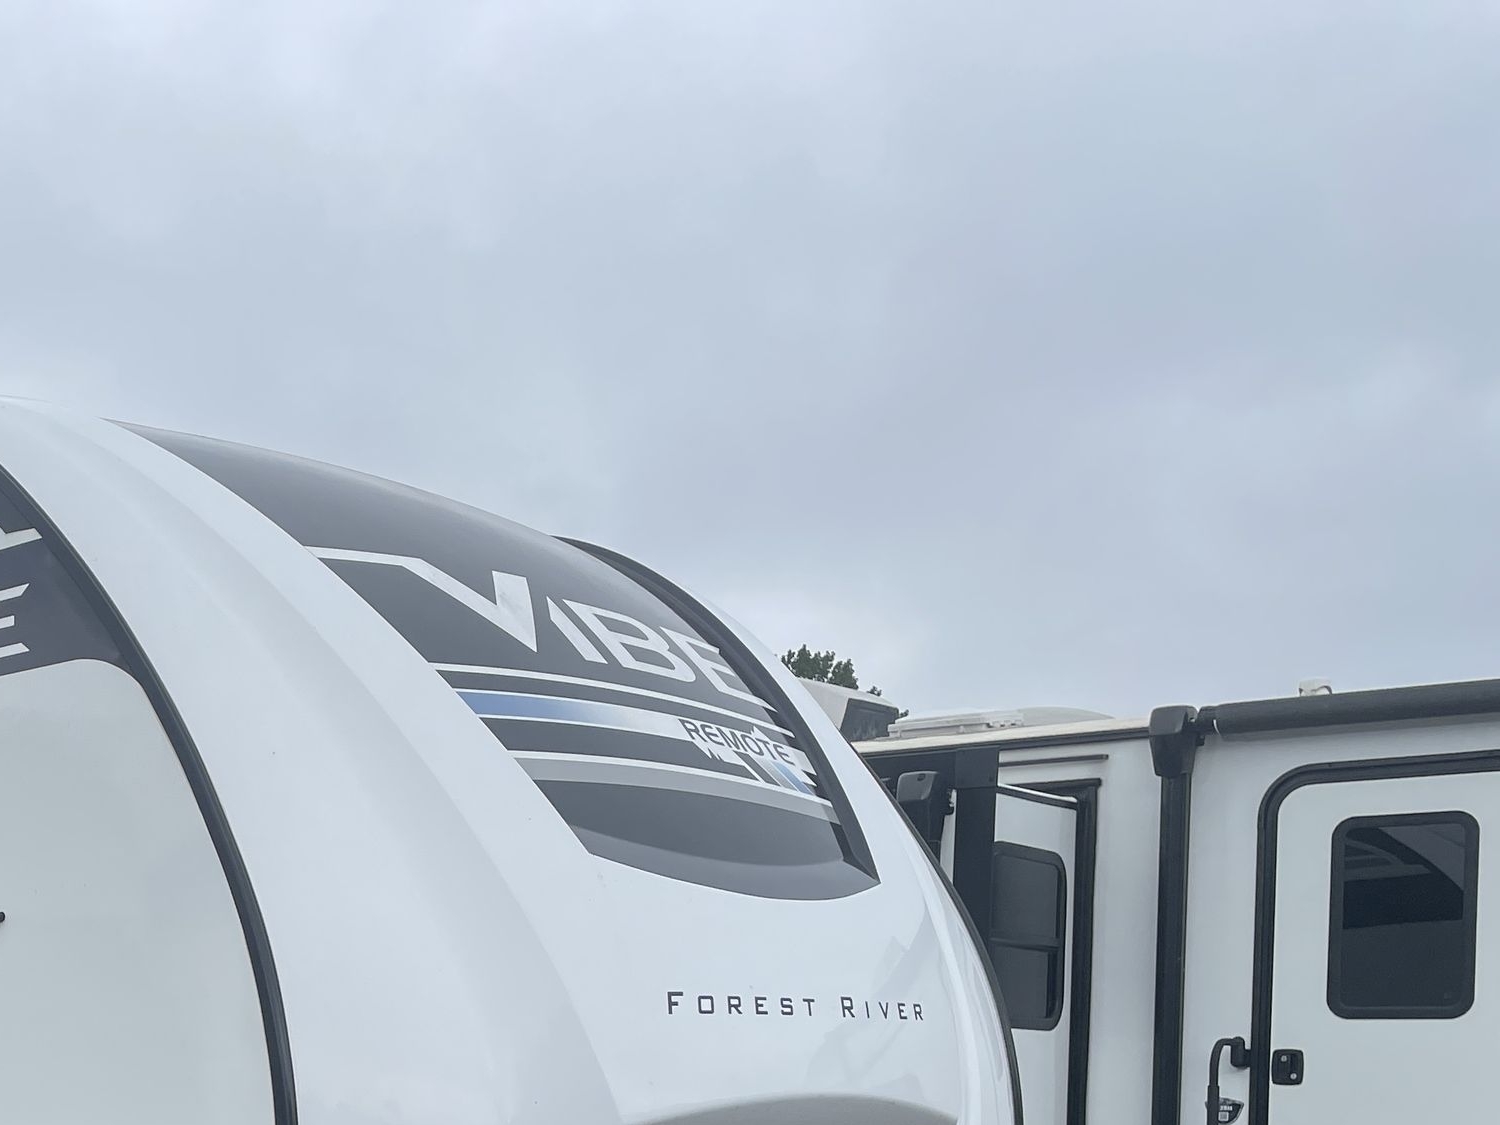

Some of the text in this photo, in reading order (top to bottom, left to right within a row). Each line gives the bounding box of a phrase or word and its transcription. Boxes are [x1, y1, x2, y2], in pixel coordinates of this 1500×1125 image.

[380, 550, 780, 712] VIBE
[678, 718, 796, 767] REMOTE
[666, 991, 925, 1021] FOREST RIVER
